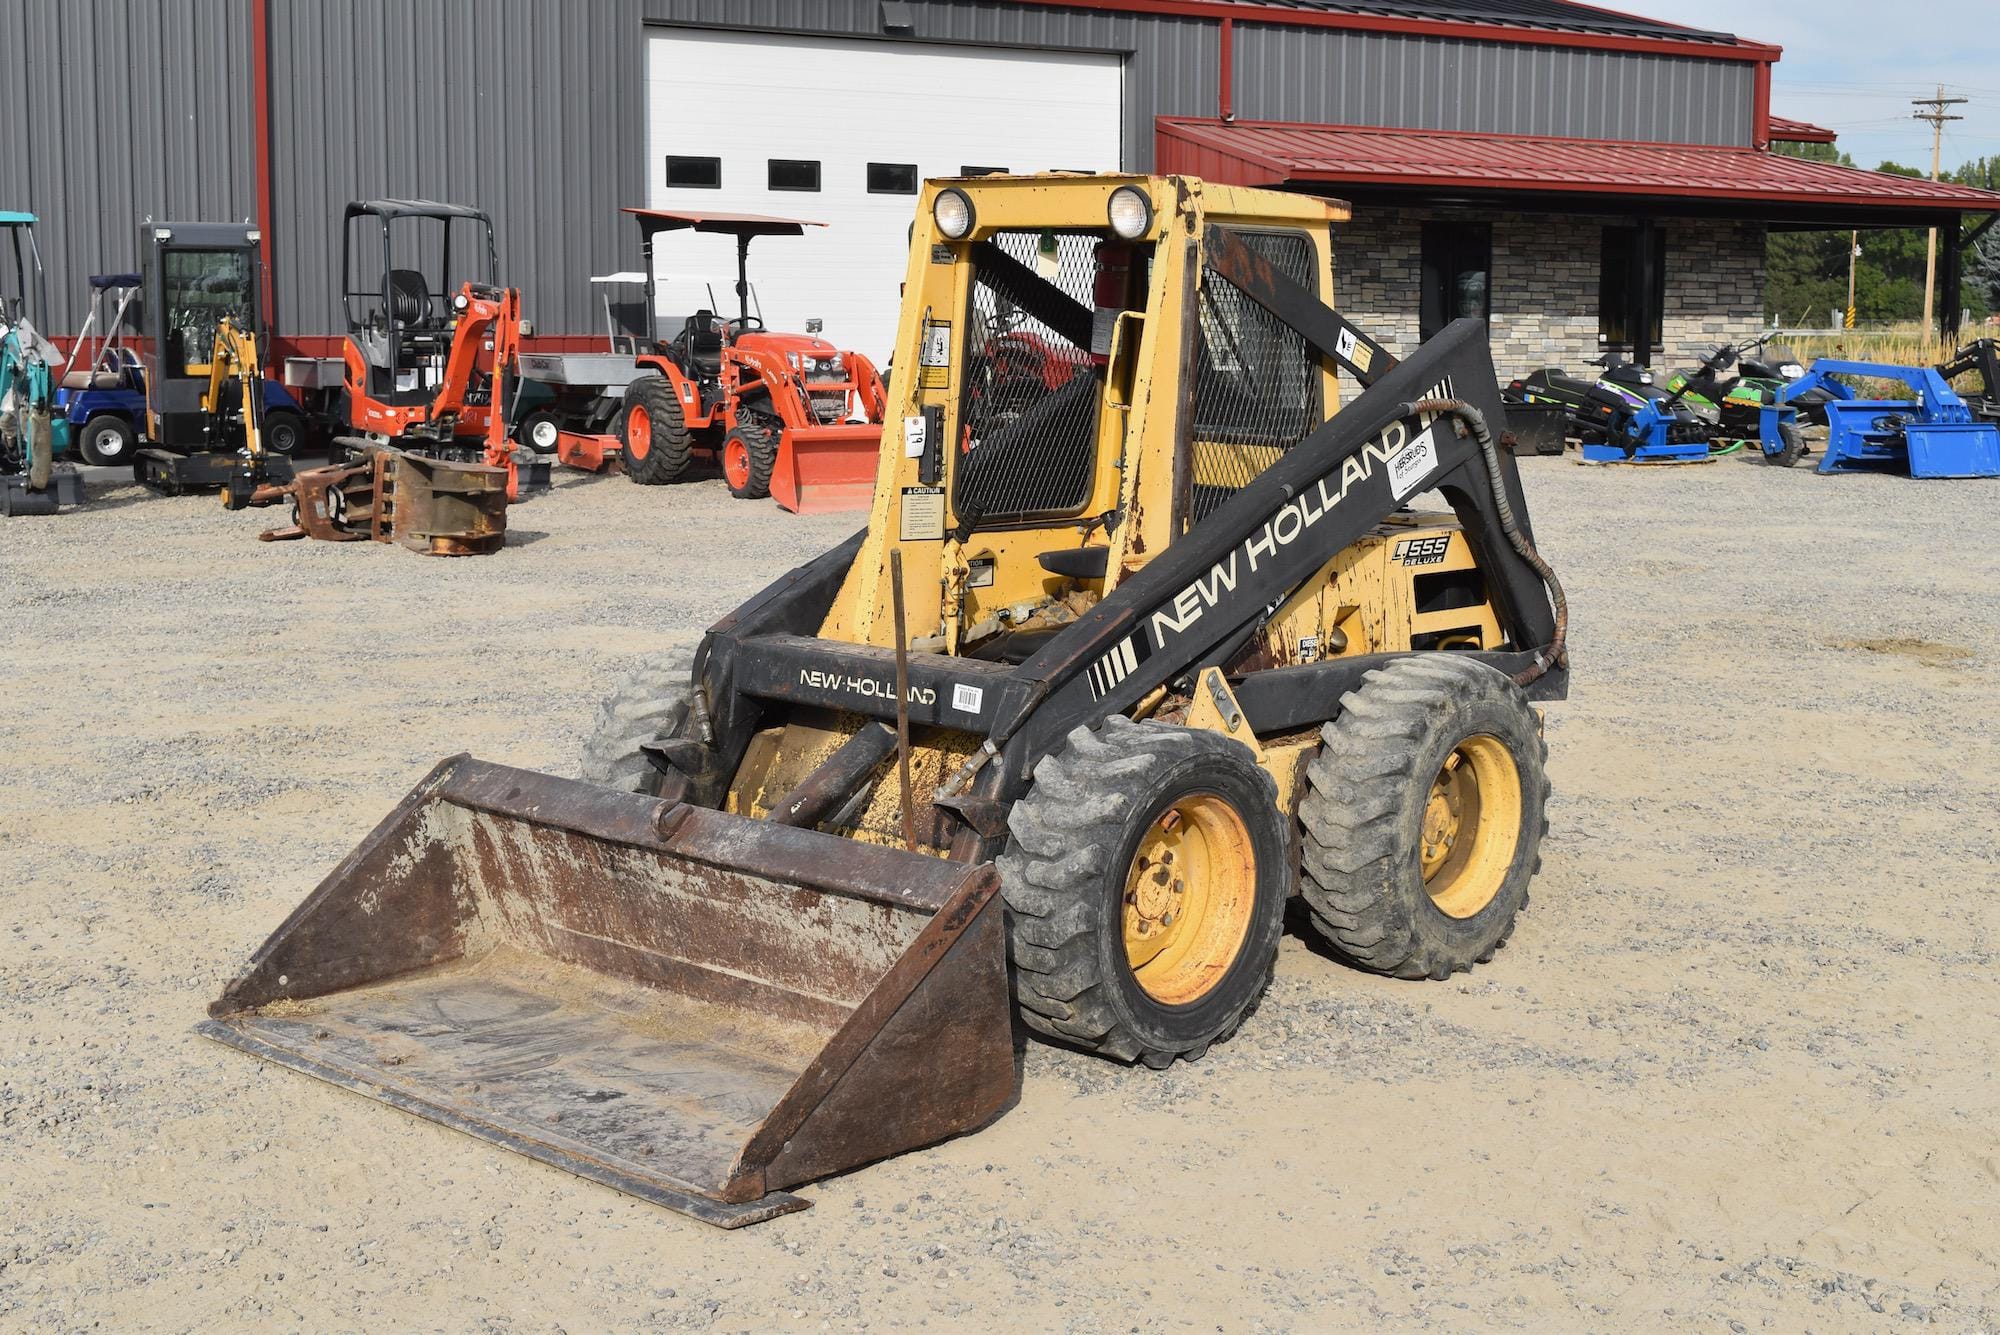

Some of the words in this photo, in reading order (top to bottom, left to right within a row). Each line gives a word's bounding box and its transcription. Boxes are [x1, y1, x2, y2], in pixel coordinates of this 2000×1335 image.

[1151, 550, 1237, 650] NEW
[1244, 419, 1406, 573] HOLLAND
[1404, 556, 1443, 566] DELUXE
[800, 669, 842, 690] NEW
